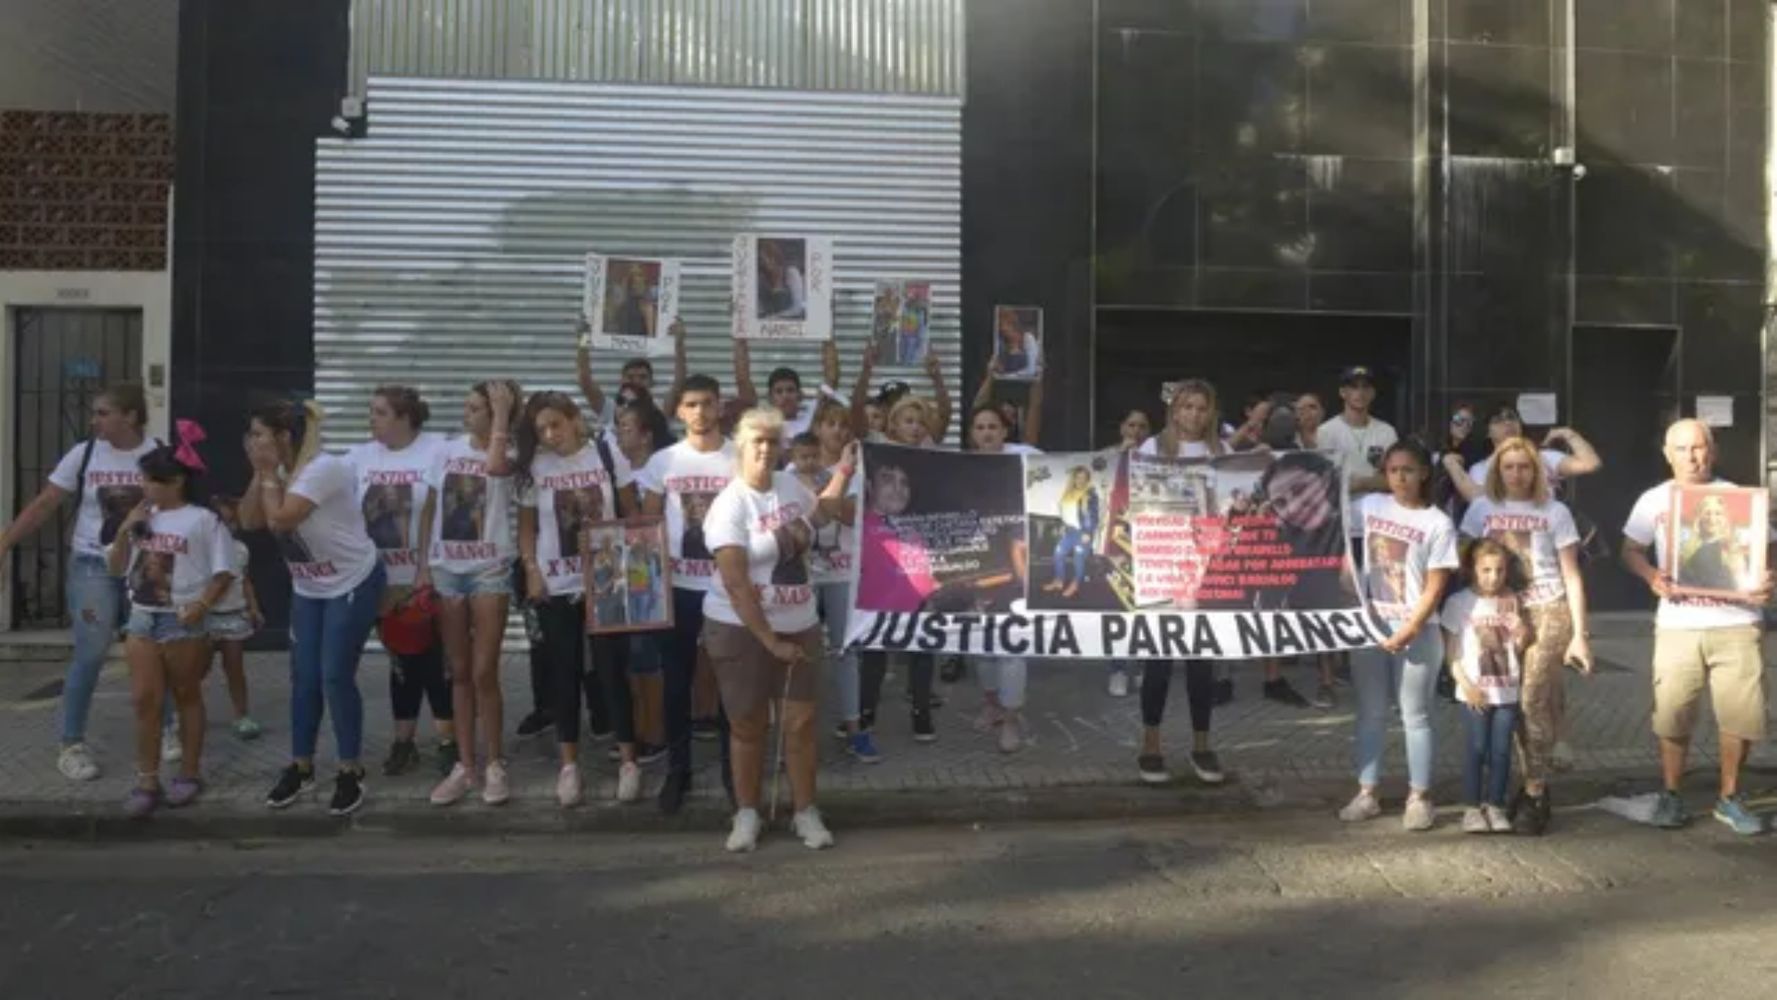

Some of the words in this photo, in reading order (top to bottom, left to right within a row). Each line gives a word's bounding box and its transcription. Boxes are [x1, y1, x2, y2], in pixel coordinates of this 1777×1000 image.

[851, 611, 1080, 656] JUSTICIA
[1101, 614, 1222, 656] PARA
[1237, 611, 1372, 655] NANCI
